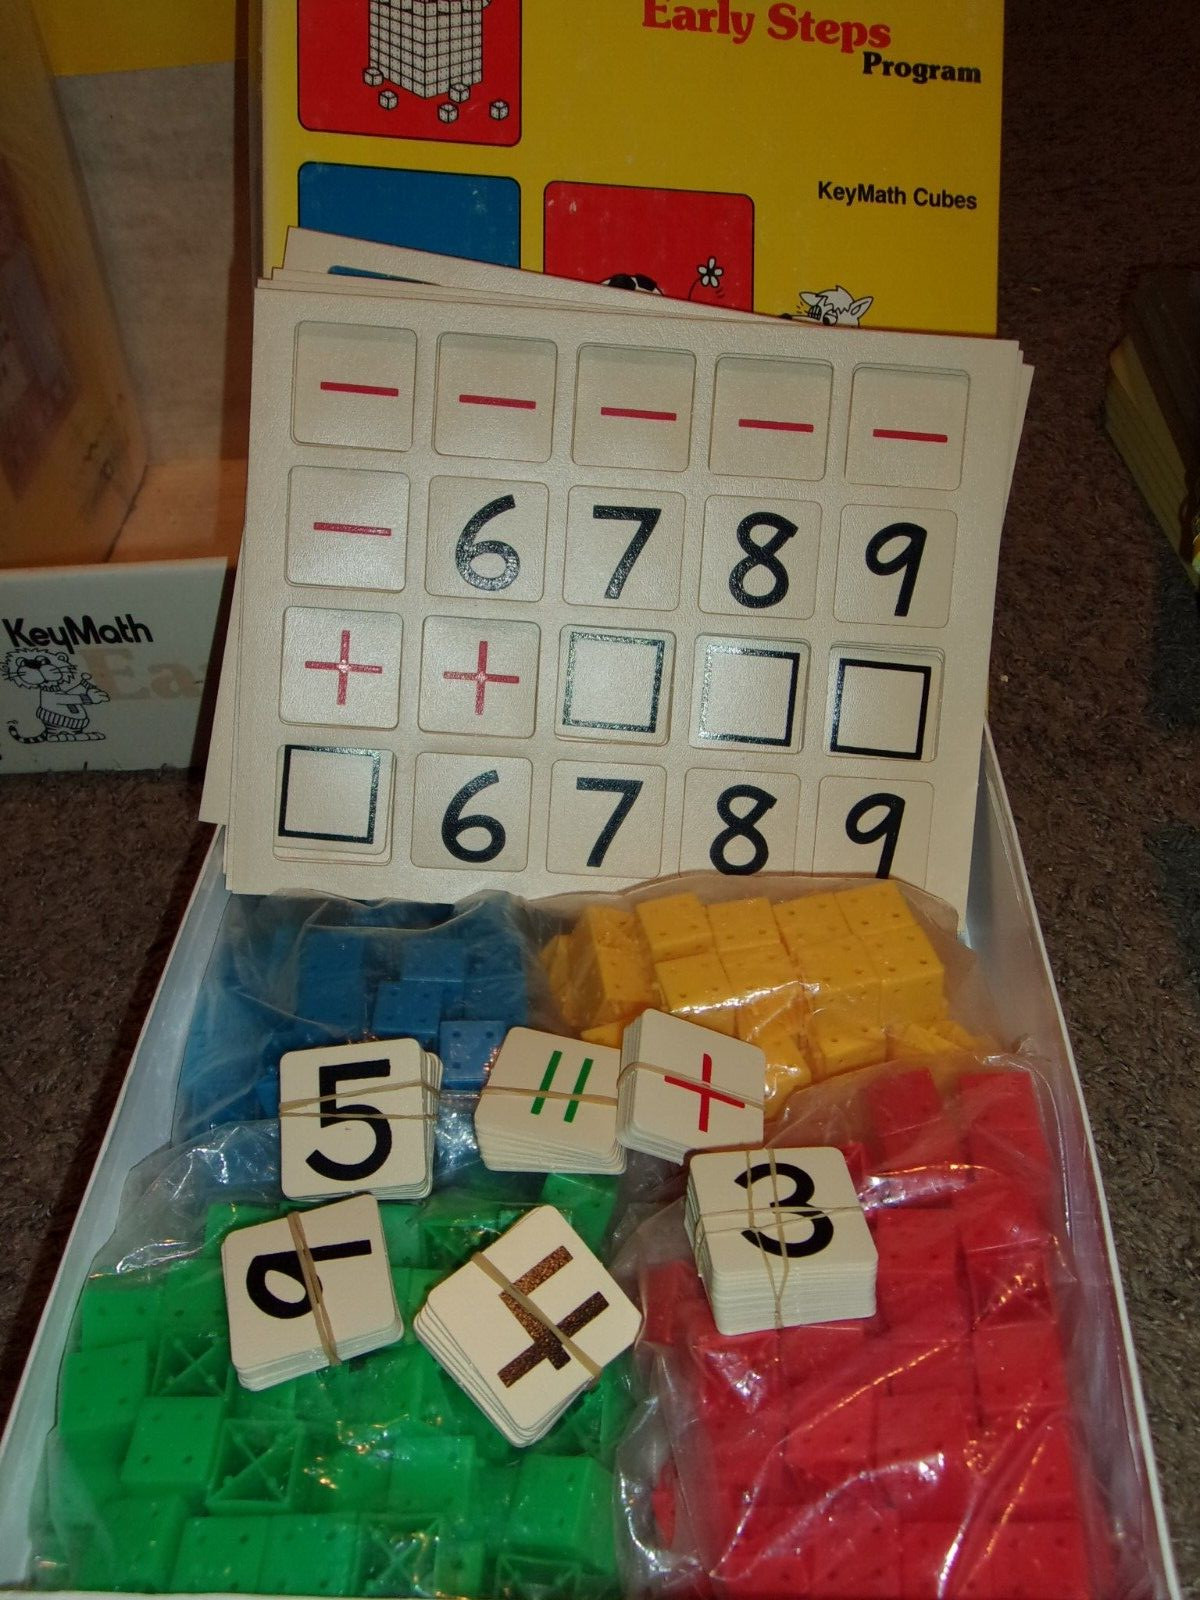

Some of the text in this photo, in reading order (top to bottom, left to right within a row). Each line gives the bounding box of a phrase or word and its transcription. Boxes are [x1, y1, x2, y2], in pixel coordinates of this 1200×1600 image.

[642, 0, 891, 54] Early Steps
[862, 51, 982, 84] Program
[818, 180, 978, 210] KeyMath Cubes
[455, 494, 520, 592] 6
[592, 504, 662, 600] 7
[729, 511, 799, 609] 8
[865, 522, 928, 617] 9
[1, 613, 154, 655] KeyMath
[440, 769, 905, 878] 6 7 8 9
[306, 1058, 393, 1182] 5
[733, 1162, 834, 1259] 3
